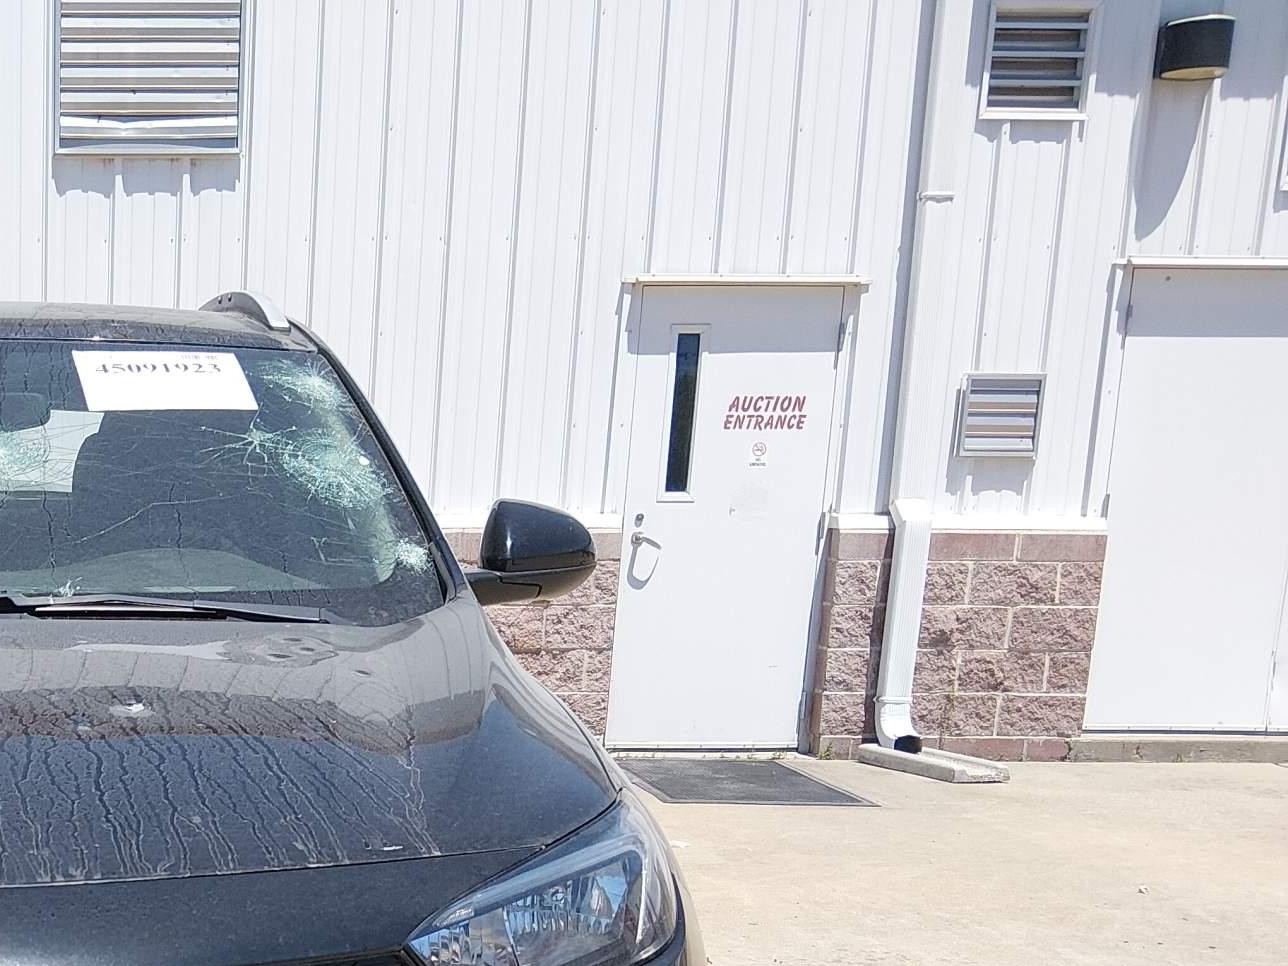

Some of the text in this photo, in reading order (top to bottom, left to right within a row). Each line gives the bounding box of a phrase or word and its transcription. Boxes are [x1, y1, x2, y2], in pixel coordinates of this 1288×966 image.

[95, 362, 222, 374] 45091923
[727, 395, 807, 413] AUCTION
[723, 414, 808, 431] ENTRANCE
